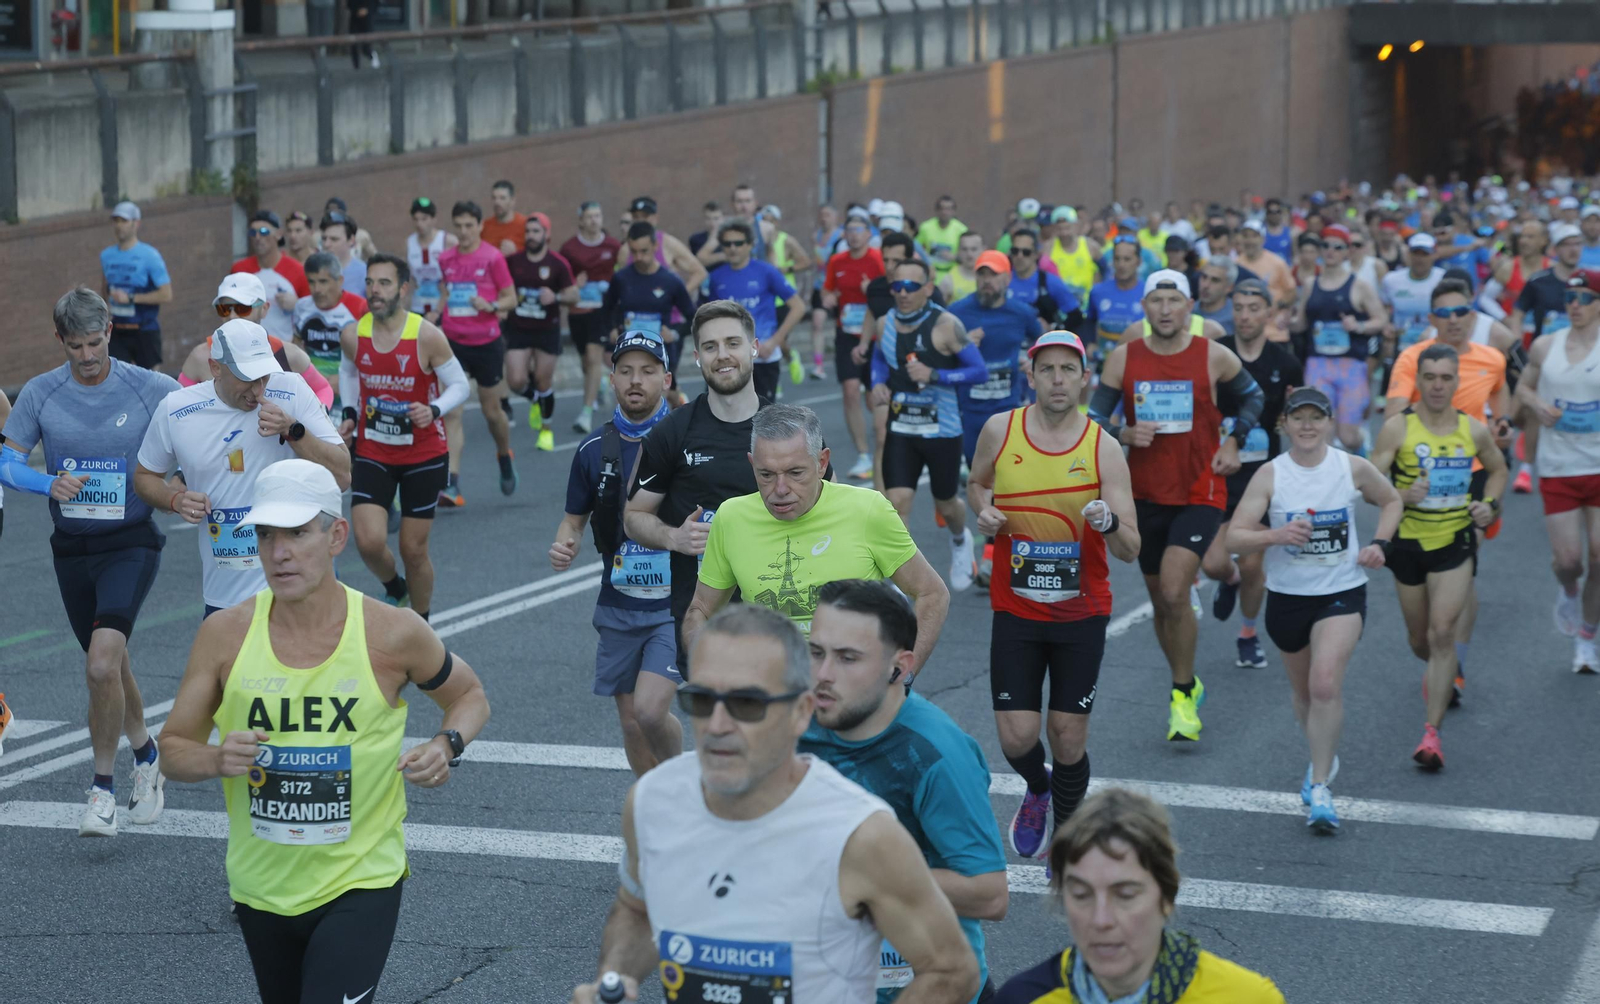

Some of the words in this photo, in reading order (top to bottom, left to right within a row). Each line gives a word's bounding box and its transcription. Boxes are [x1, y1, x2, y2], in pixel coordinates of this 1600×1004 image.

[1154, 384, 1186, 392] ZURICH
[273, 391, 291, 400] HELA
[175, 401, 215, 420] RUNNERS
[1158, 412, 1170, 420] MY
[375, 421, 401, 434] NIETO
[81, 460, 118, 470] ZURICH
[84, 478, 101, 487] 503
[232, 530, 254, 539] 6008
[212, 547, 239, 557] LUCAS
[1033, 545, 1072, 555] ZURICH
[633, 562, 652, 571] 4701
[1034, 563, 1056, 573] 3905
[625, 572, 664, 585] KEVIN
[1027, 574, 1062, 589] GREG
[248, 696, 360, 733] ALEX
[278, 752, 338, 766] ZURICH
[280, 780, 312, 795] 3172
[250, 797, 351, 821] ALEXANDRE
[699, 944, 775, 968] ZURICH
[702, 982, 742, 1004] 3325
